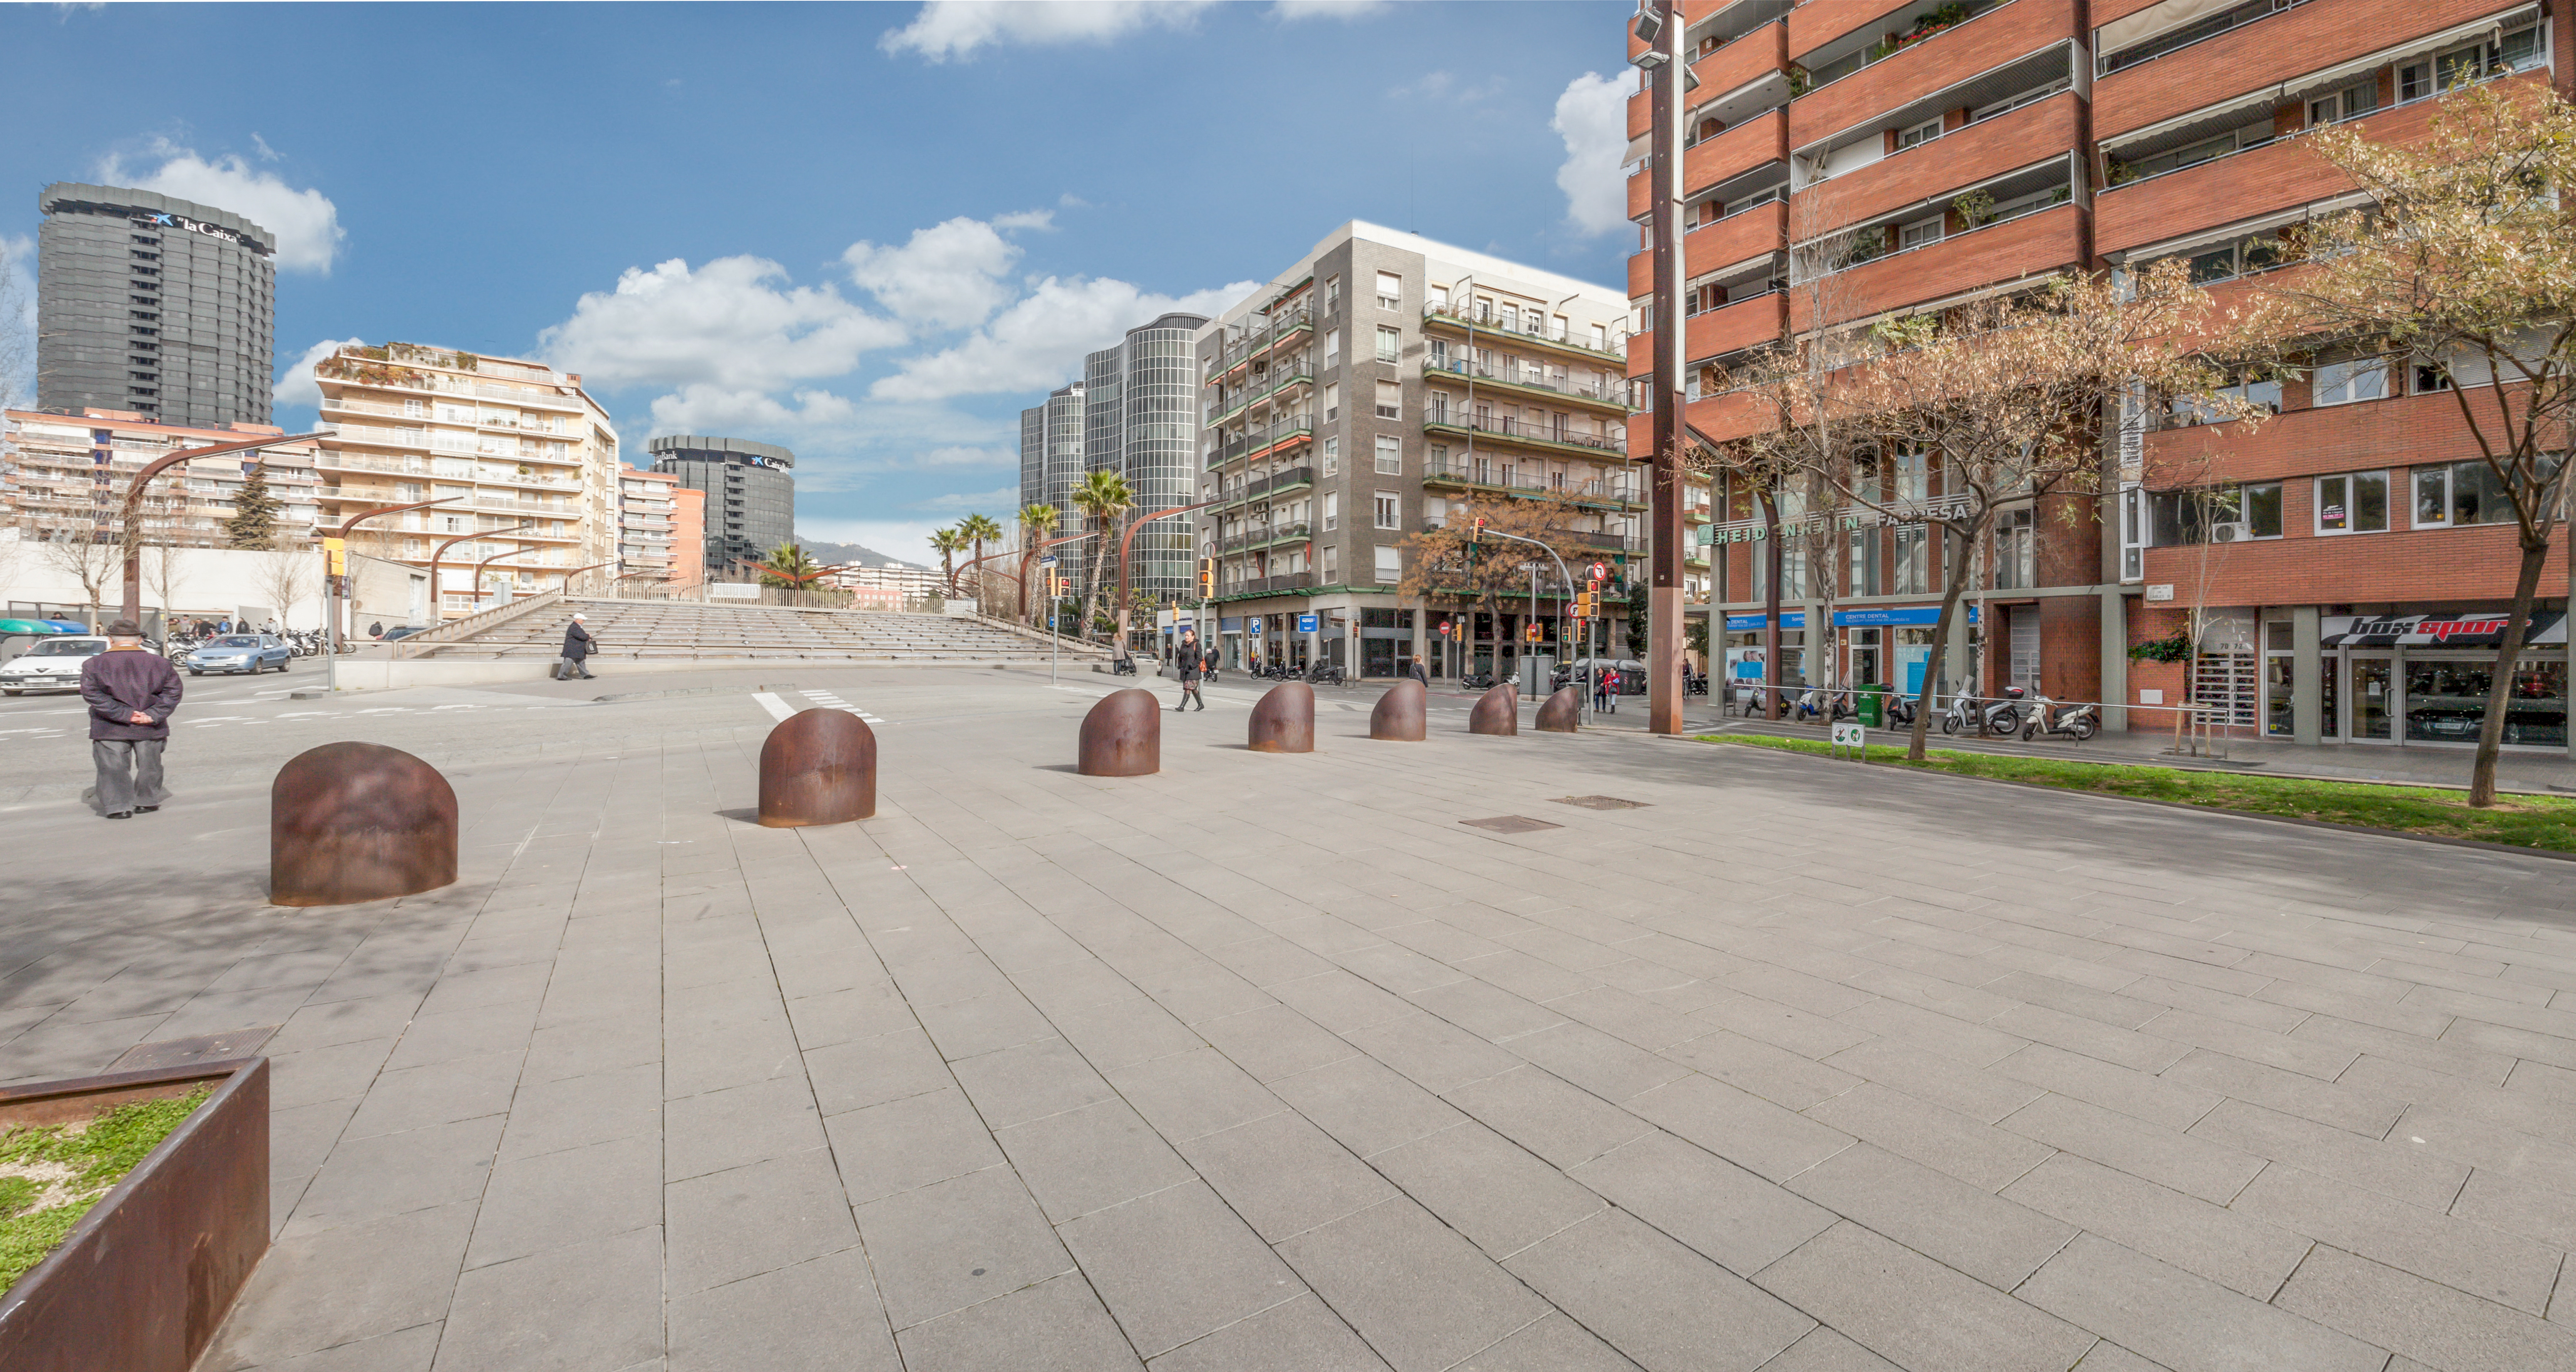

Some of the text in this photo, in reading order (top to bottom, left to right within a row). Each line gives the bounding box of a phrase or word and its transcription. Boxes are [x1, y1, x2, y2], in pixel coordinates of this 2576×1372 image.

[1718, 516, 1859, 544] HEIDNHIN
[1253, 619, 1260, 628] P
[2348, 617, 2532, 642] box spor
